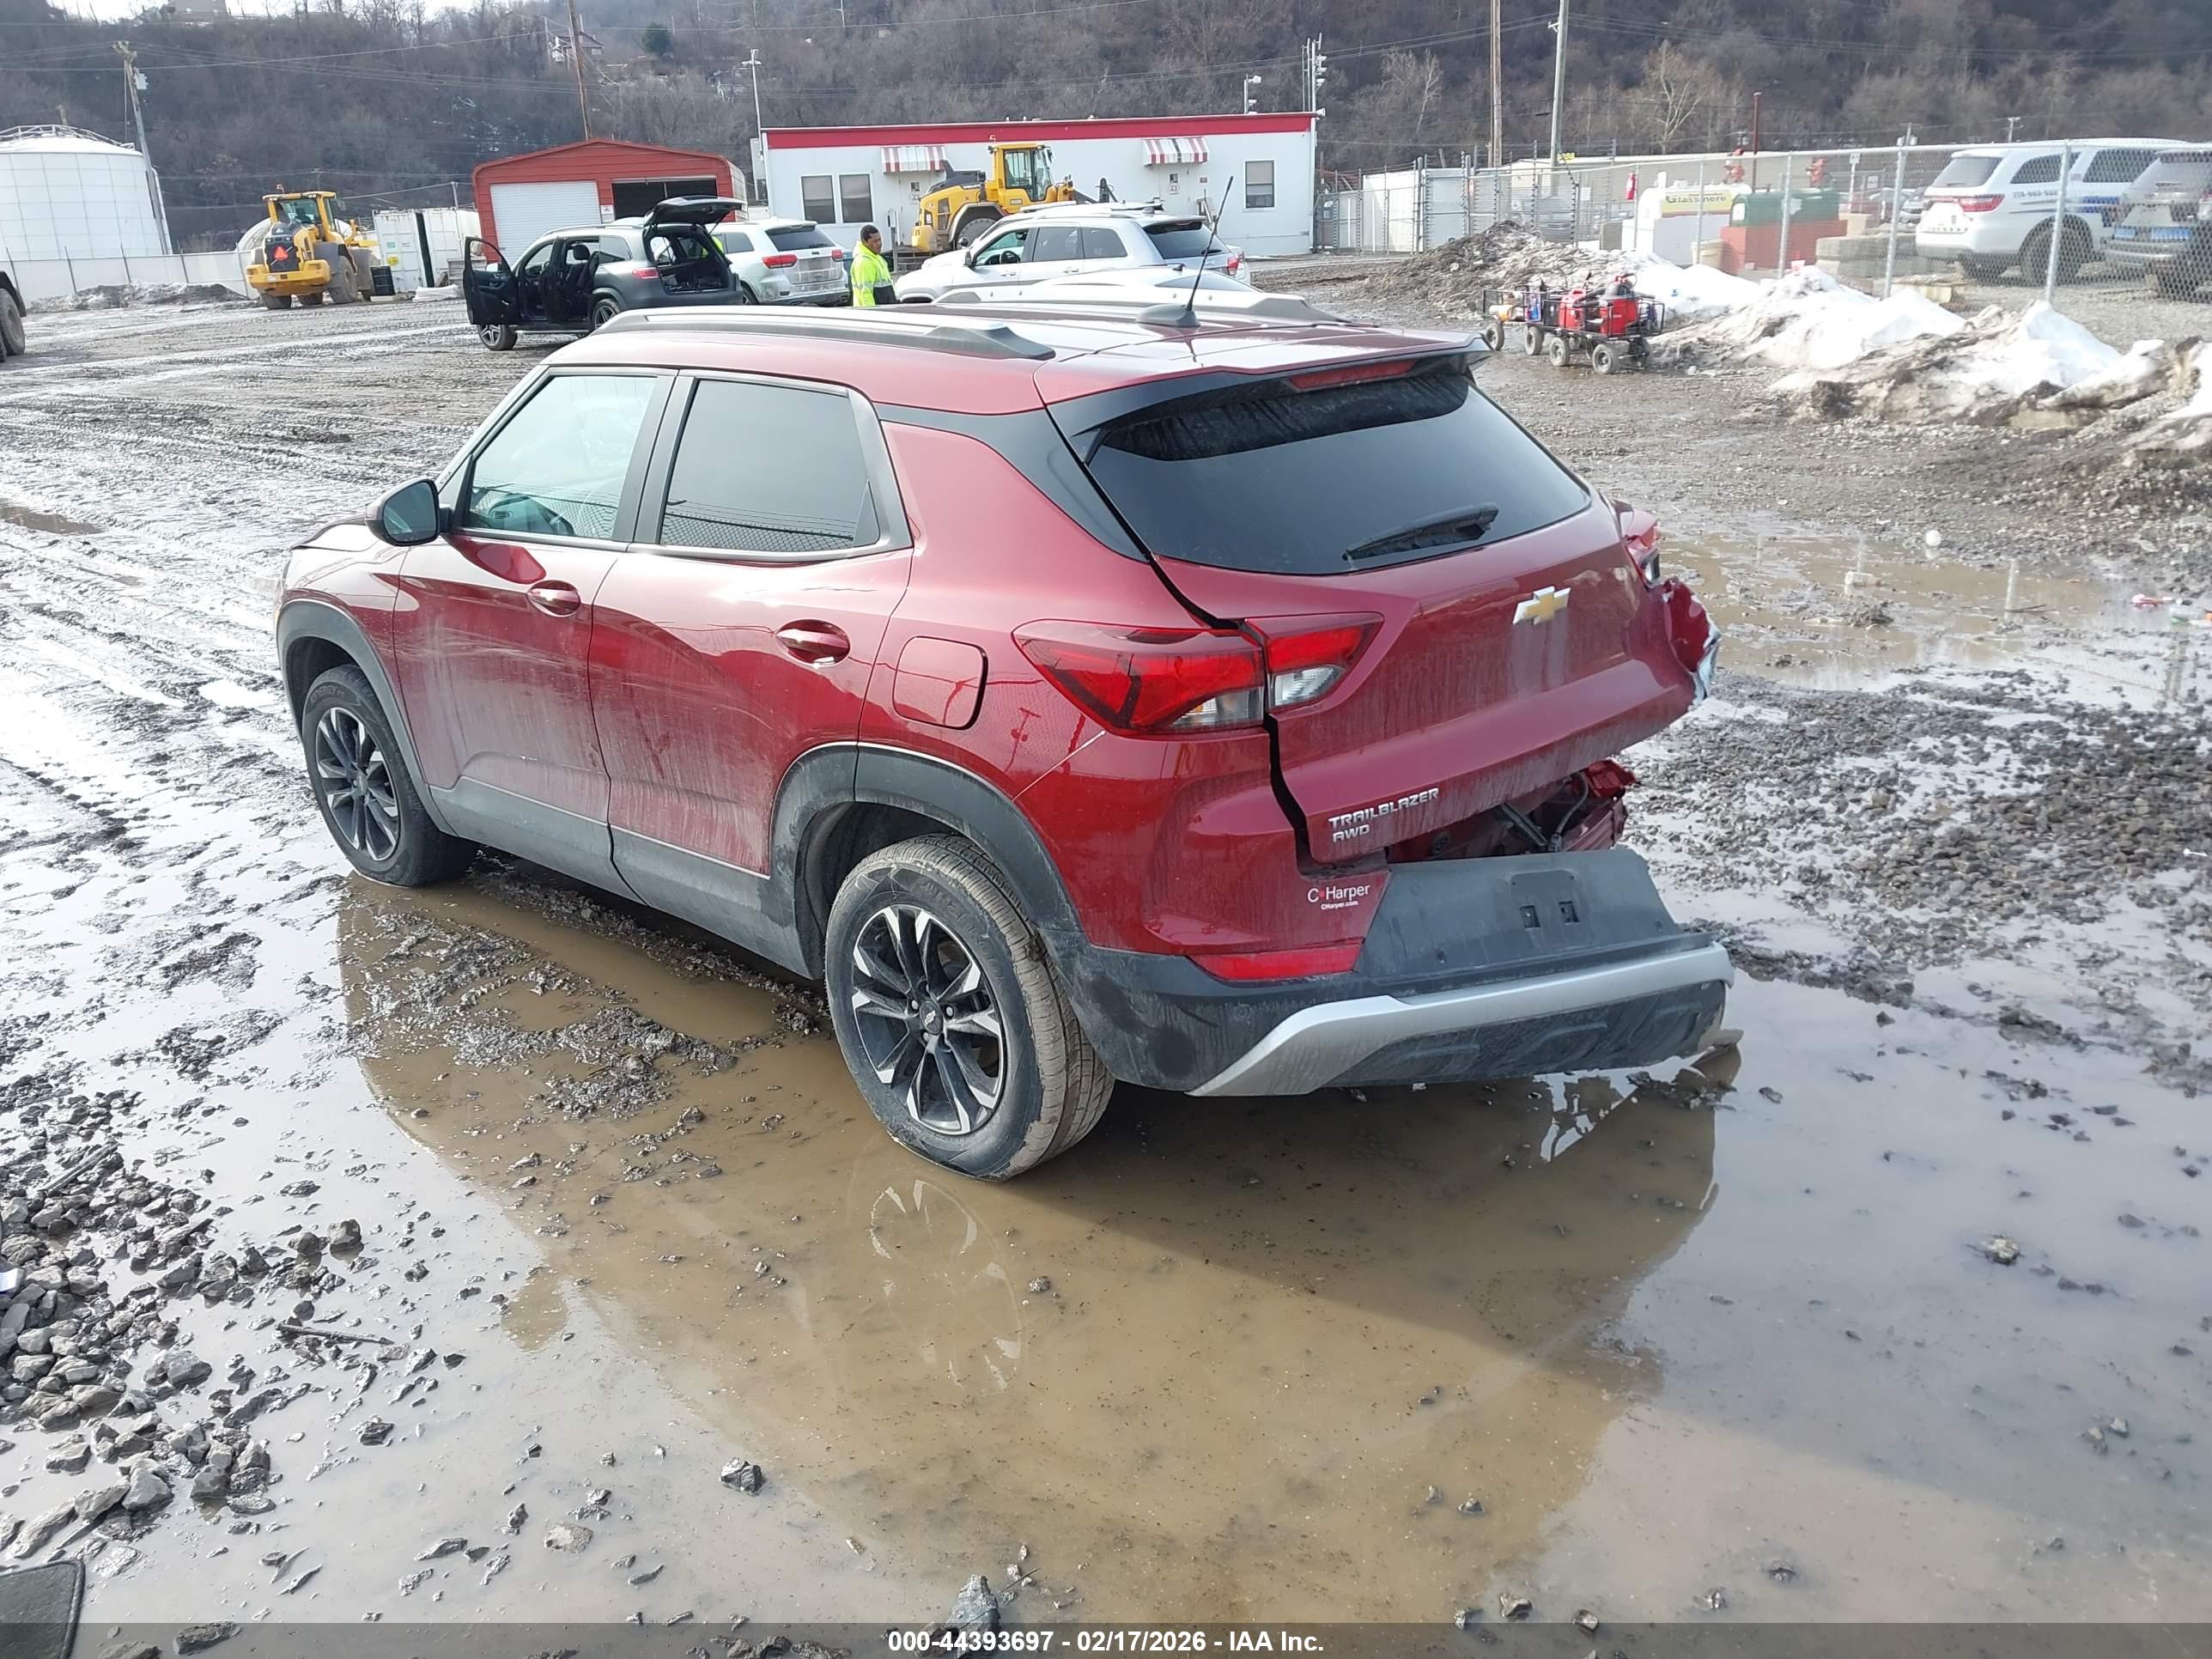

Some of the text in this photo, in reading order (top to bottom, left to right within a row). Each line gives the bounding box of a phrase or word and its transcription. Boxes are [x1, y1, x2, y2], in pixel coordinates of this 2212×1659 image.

[1328, 787, 1439, 829] TRAILBLAZER
[1333, 824, 1370, 842] AWD
[1326, 884, 1370, 901] Harper
